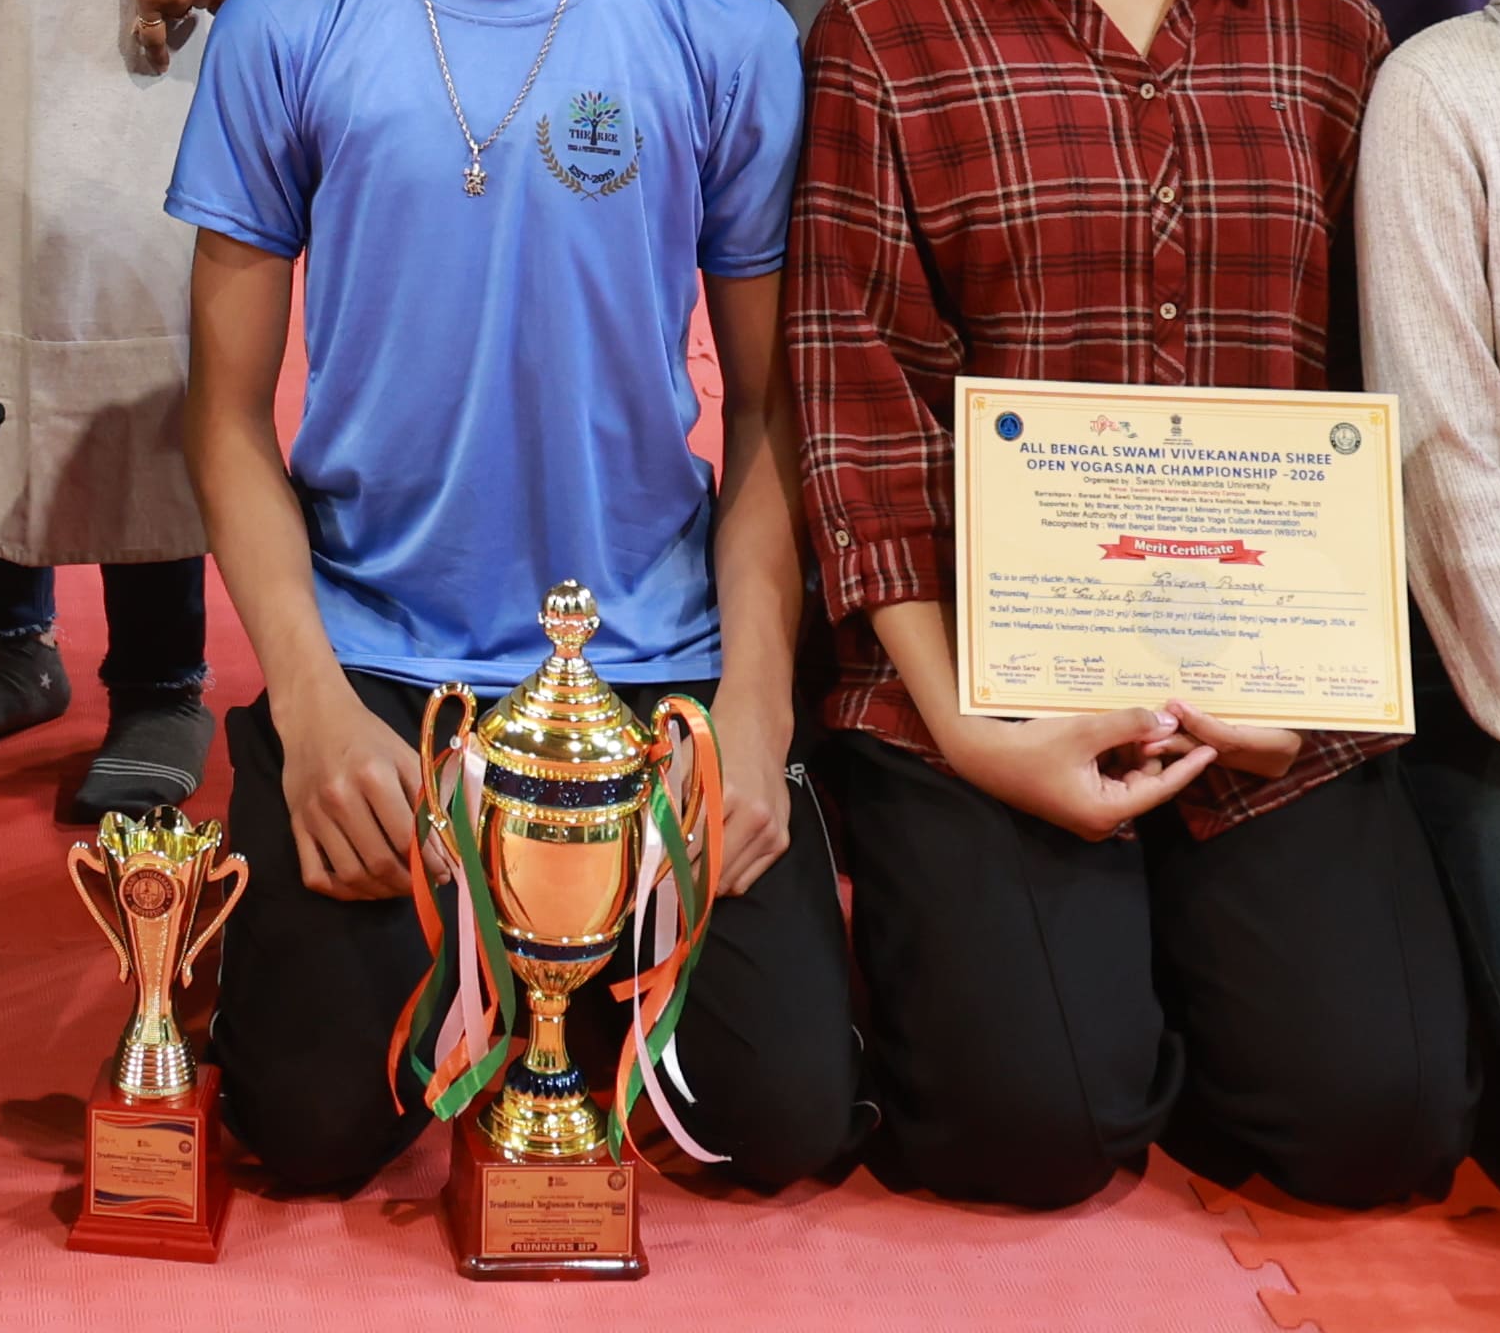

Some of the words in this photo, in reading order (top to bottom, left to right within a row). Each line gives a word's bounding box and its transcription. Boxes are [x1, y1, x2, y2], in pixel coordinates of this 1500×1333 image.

[1019, 442, 1045, 453] ALL
[1049, 443, 1108, 456] BENGAL
[1112, 446, 1165, 458] SWAMI
[1171, 448, 1281, 463] VIVEKANANDA
[1286, 452, 1331, 465] SHREE
[1026, 459, 1065, 471] OPEN
[1070, 460, 1156, 475] YOGASANA
[1161, 464, 1277, 480] CHAMPIONSHIP
[1134, 539, 1168, 553] Merit
[1170, 541, 1234, 558] Certificate
[514, 1243, 574, 1251] RUNNERS
